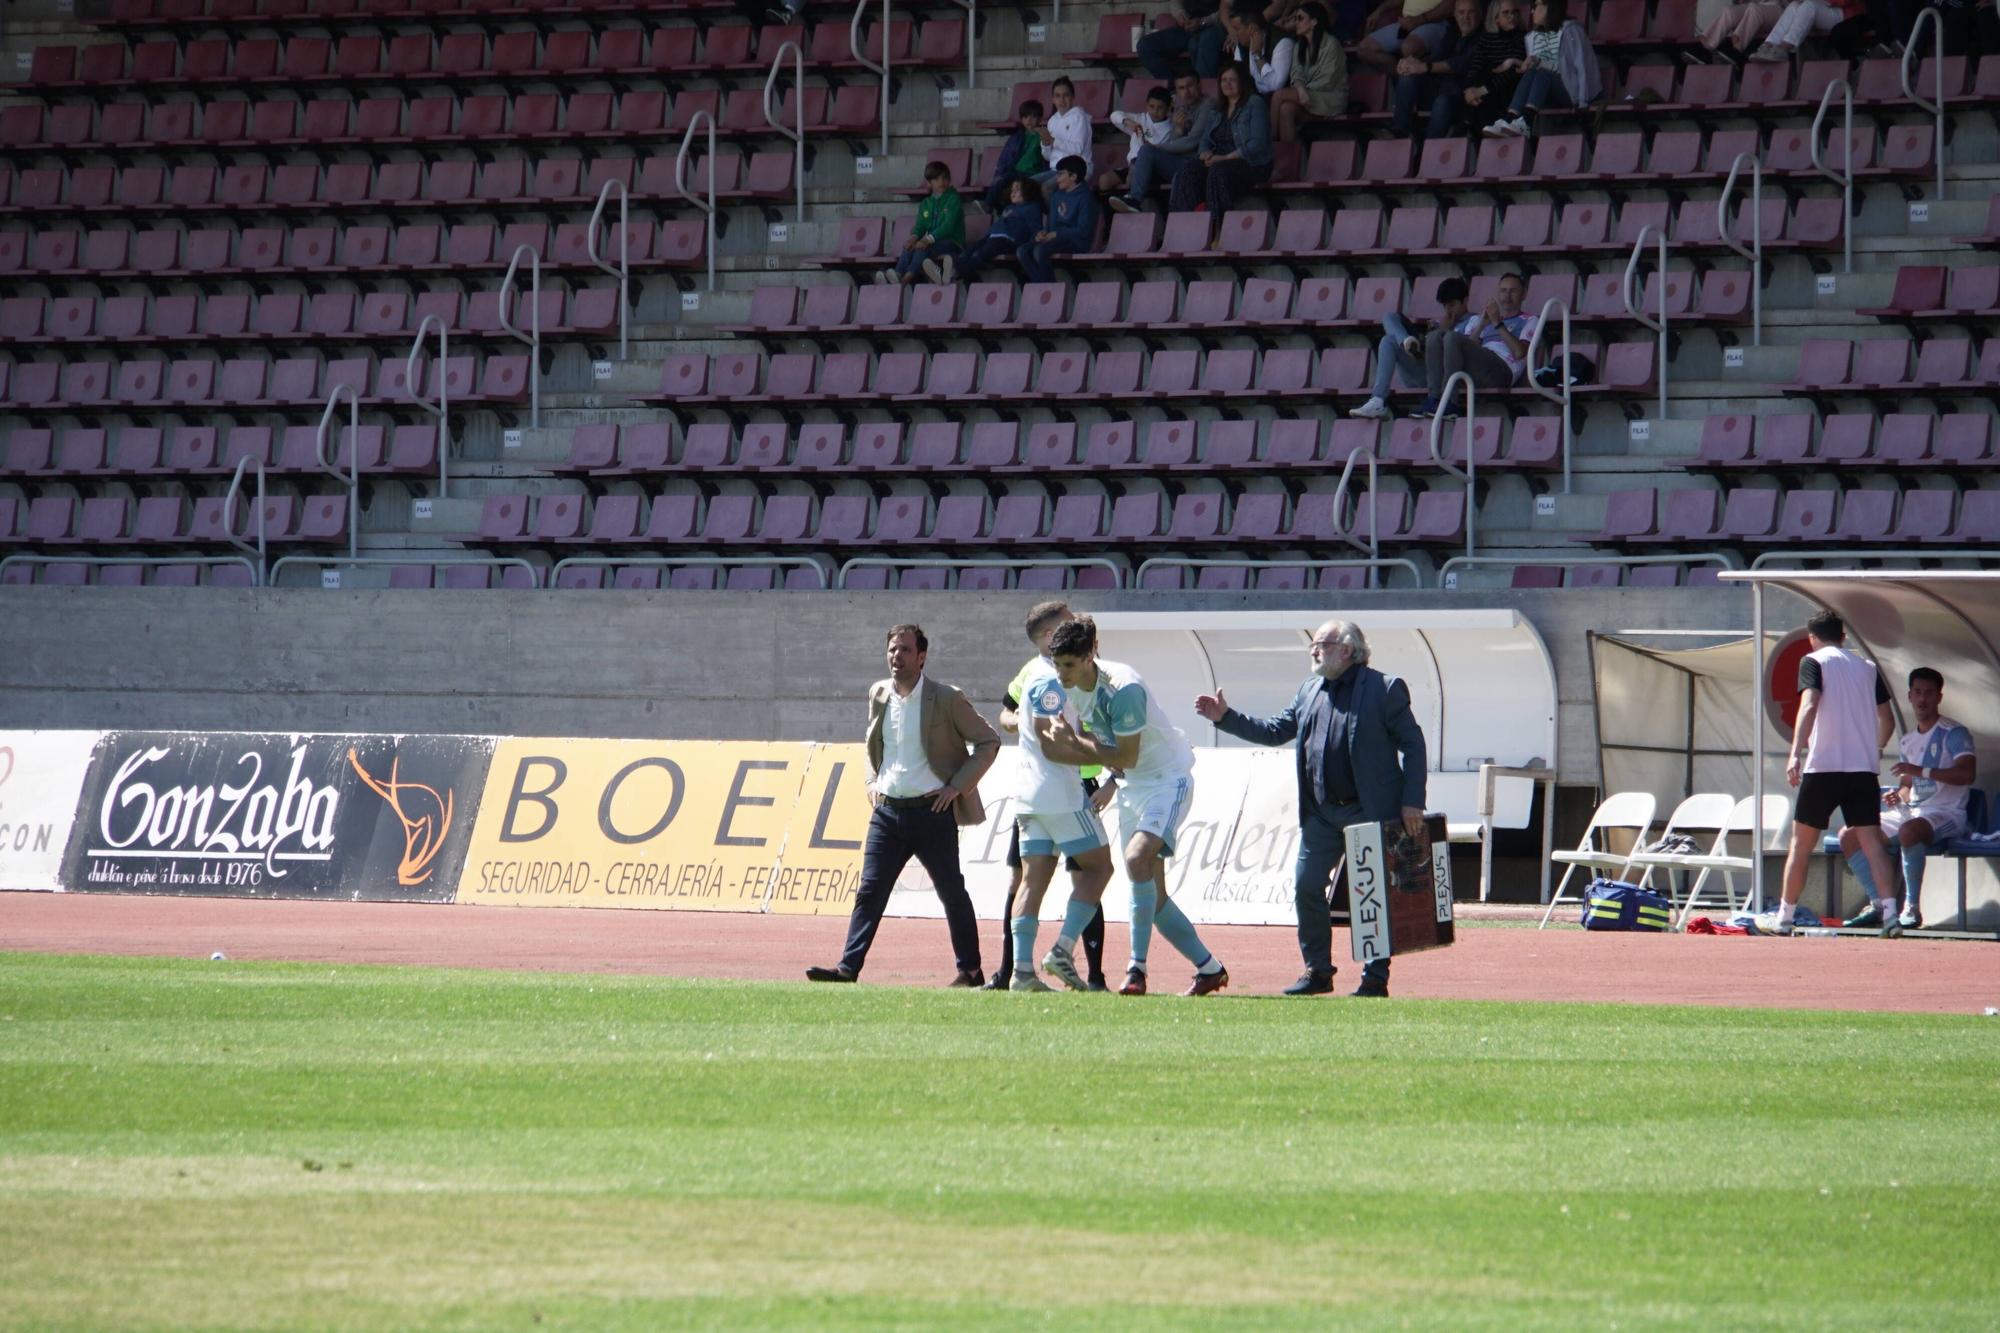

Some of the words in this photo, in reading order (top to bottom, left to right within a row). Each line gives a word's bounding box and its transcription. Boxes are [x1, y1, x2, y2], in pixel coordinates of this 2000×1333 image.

[101, 745, 339, 878] Gonzaba
[498, 756, 862, 851] BOEL
[126, 871, 133, 883] e
[169, 861, 194, 884] brasa
[197, 862, 222, 885] desde
[225, 862, 263, 886] 1976
[476, 861, 591, 895] SEGURIDAD
[605, 857, 722, 899] CERRAJERÍA
[739, 862, 861, 903] FERRETERÍA
[1203, 873, 1260, 904] desde
[1355, 845, 1381, 958] PLEXUS
[1434, 855, 1450, 918] PLEXUS
